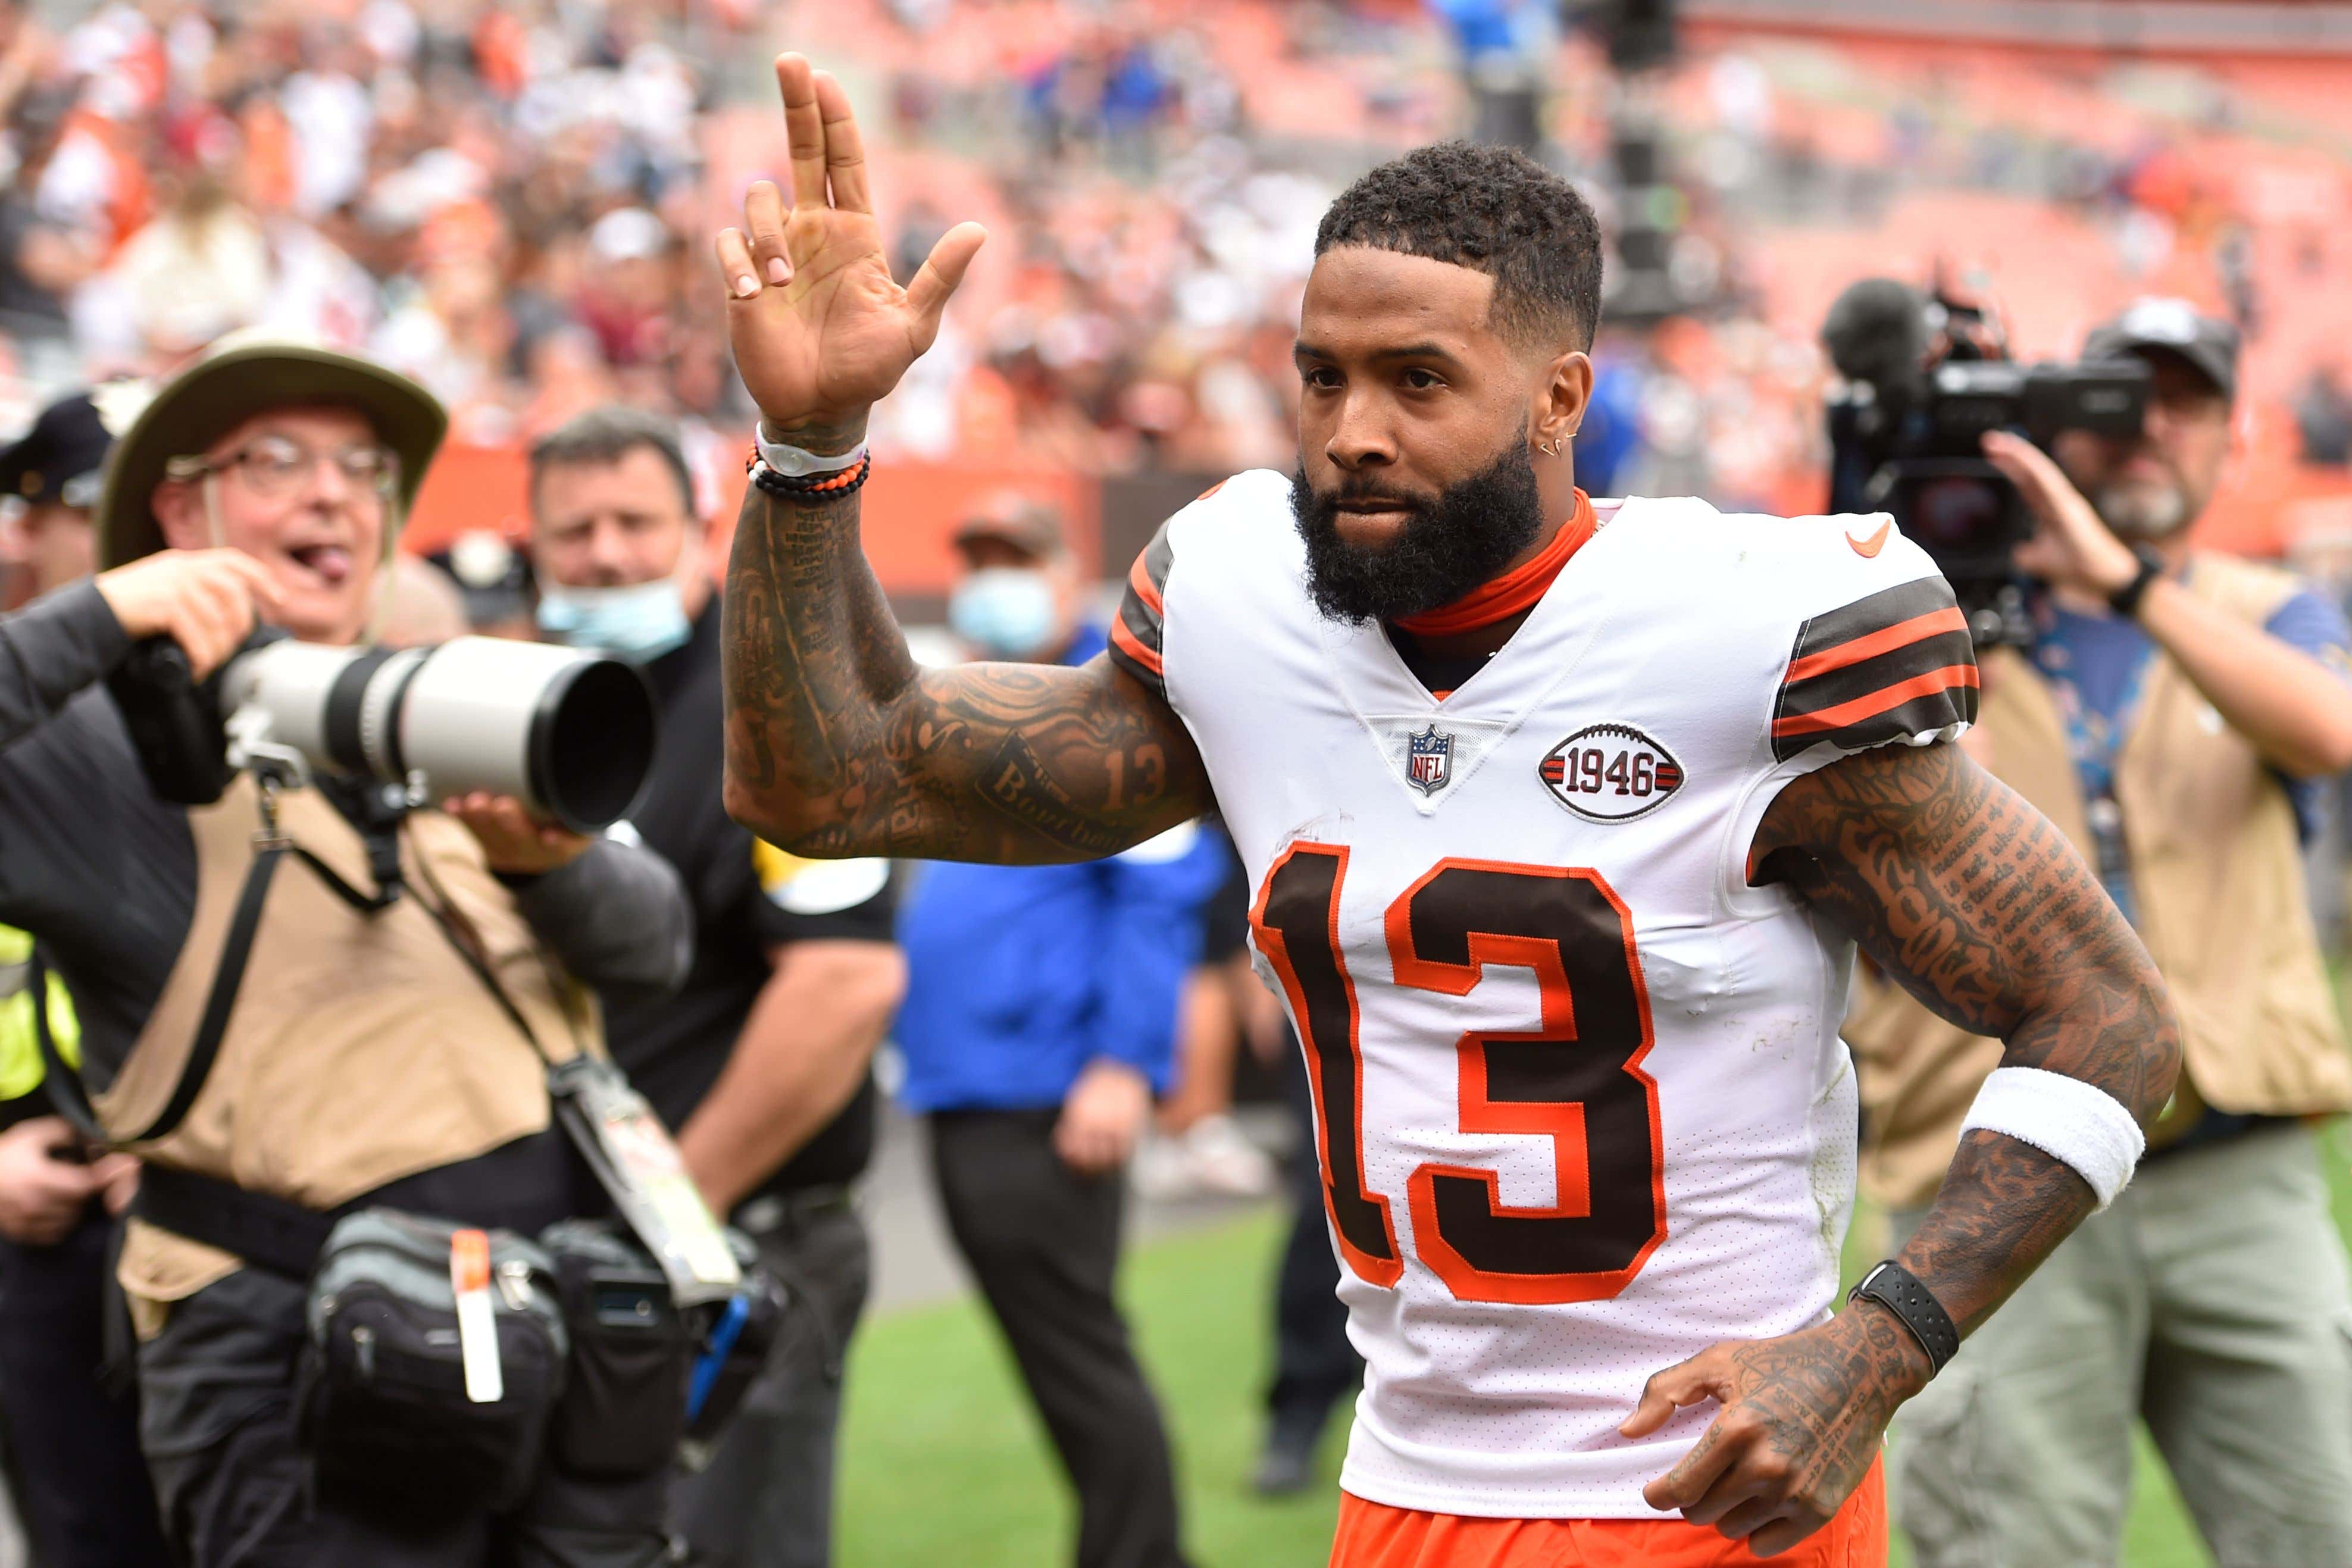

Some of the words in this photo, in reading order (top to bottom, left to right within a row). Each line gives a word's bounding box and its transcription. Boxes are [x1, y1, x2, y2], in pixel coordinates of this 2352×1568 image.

[1103, 742, 1168, 813] 13
[1413, 755, 1444, 781] NFL
[1566, 747, 1654, 797] 1946
[1248, 840, 1667, 1305] 13
